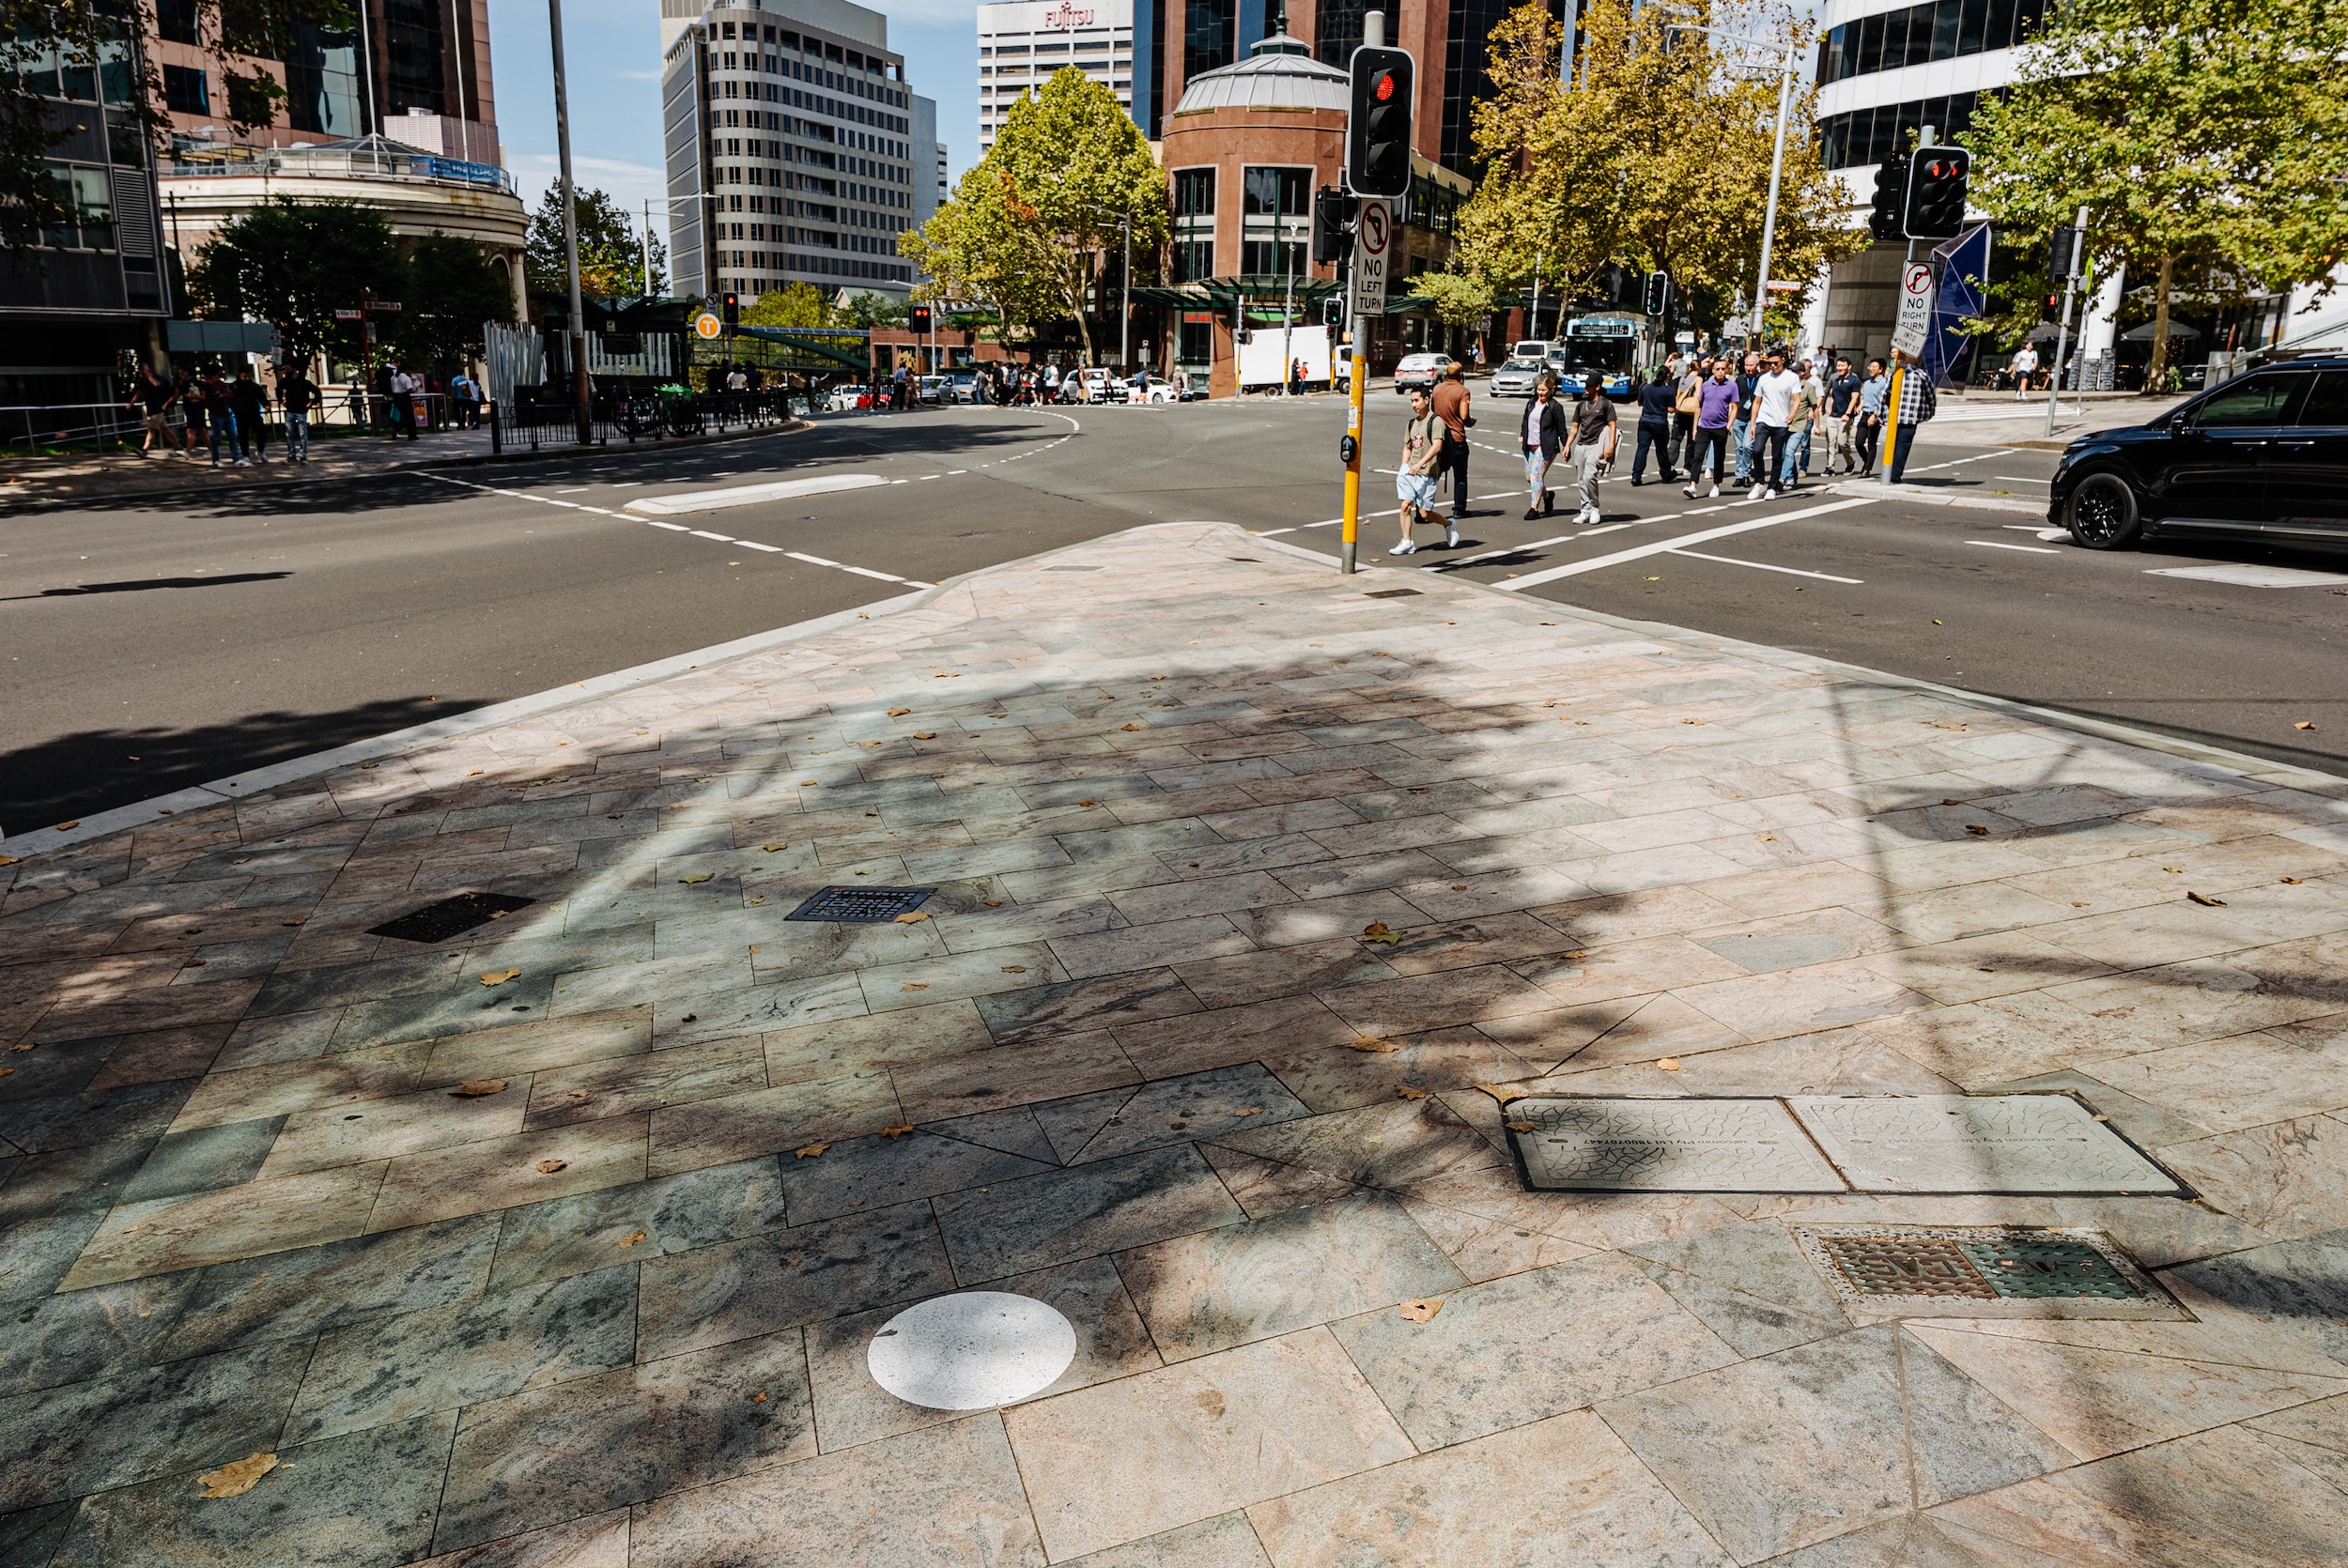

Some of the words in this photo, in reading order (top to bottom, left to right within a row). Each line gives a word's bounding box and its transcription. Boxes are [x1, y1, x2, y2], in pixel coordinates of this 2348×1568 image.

[1045, 8, 1094, 30] FUJITSU
[1364, 259, 1382, 276] NO
[1361, 280, 1383, 293] LEFT
[1359, 297, 1383, 310] TURN
[1907, 298, 1924, 309] NO
[1902, 311, 1927, 320] RIGHT
[703, 320, 714, 334] T
[1611, 326, 1624, 334] 115
[1902, 322, 1924, 331] URN
[1903, 331, 1917, 343] INTO
[1893, 337, 1912, 350] MOUNT
[1911, 345, 1920, 353] ST
